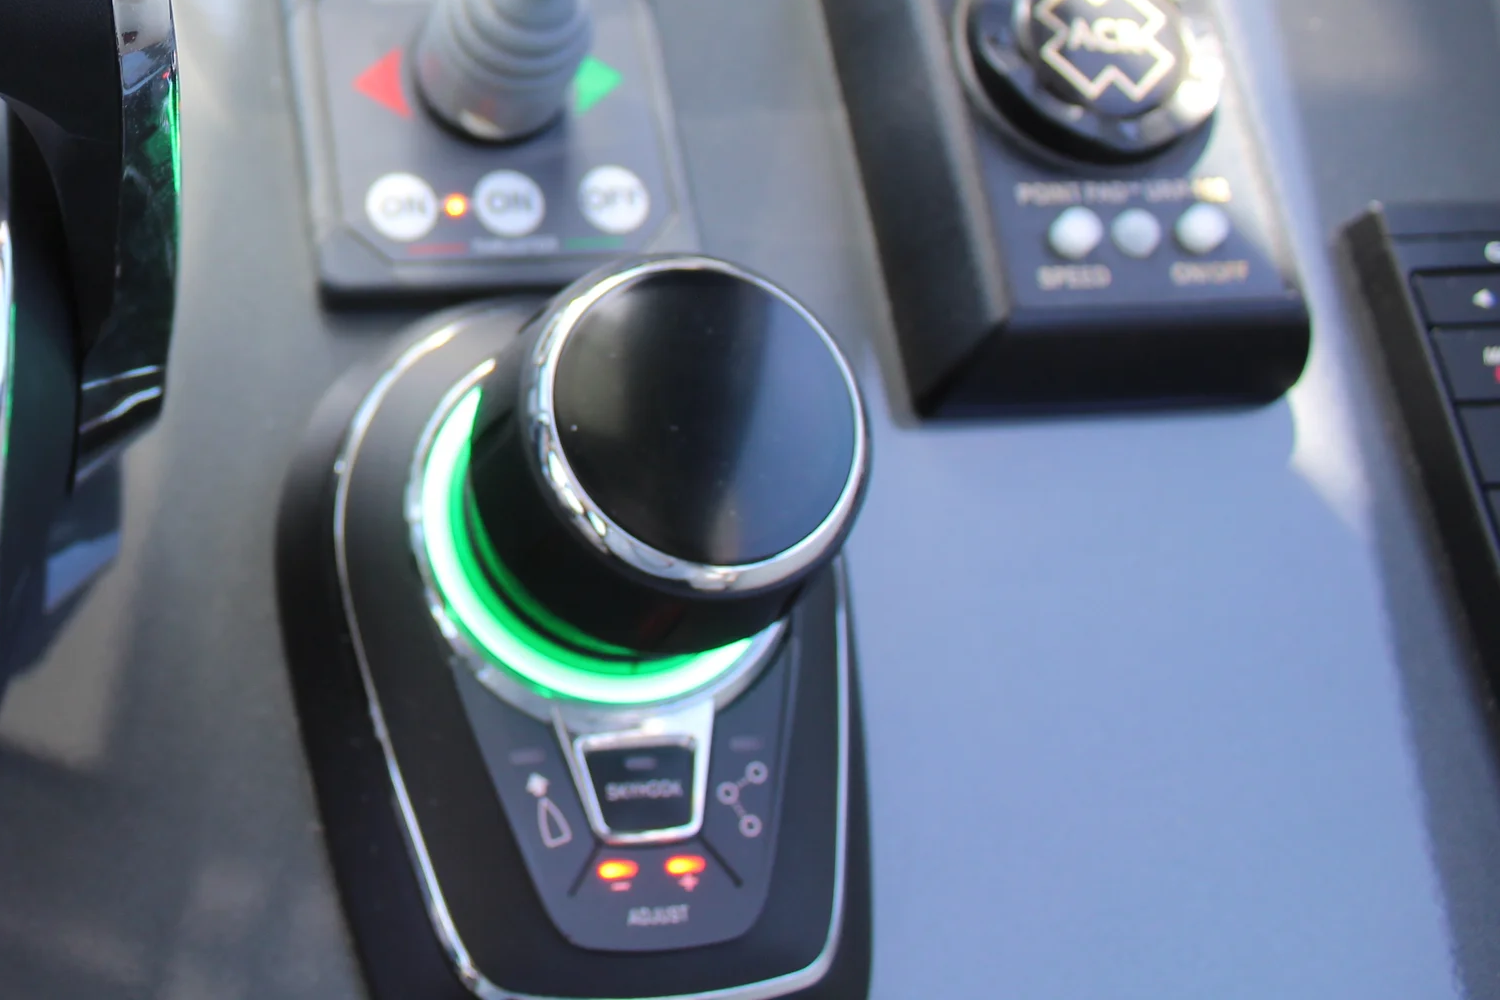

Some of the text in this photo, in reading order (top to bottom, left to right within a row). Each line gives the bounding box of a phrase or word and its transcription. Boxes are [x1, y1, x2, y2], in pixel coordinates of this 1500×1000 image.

[381, 193, 429, 218] ON
[483, 189, 534, 215] ON
[626, 904, 691, 927] ADJUST
